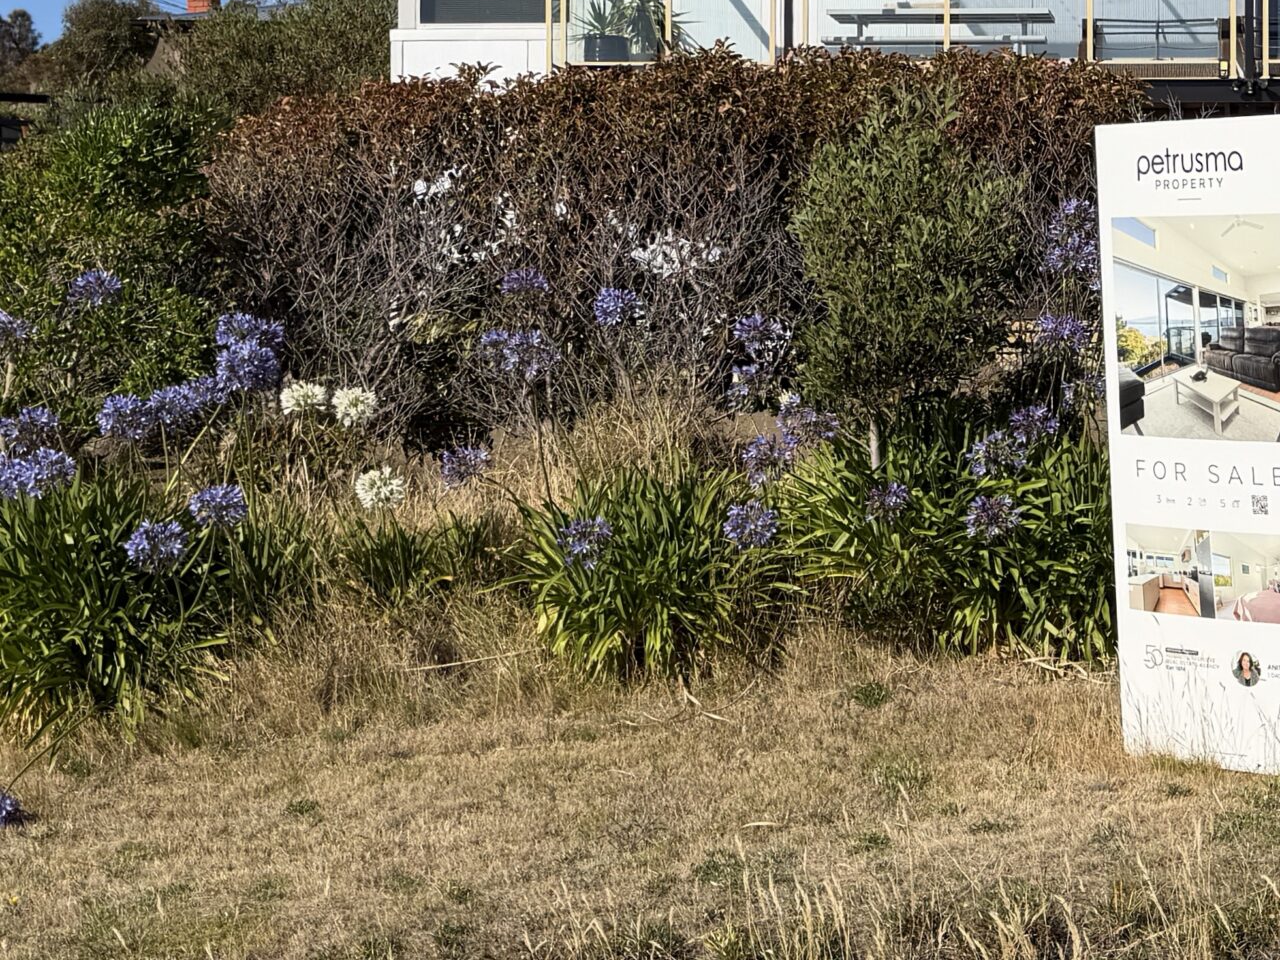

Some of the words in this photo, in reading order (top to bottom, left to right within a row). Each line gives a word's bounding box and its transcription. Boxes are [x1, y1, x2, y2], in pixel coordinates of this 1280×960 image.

[1136, 147, 1244, 182] petrusma
[1154, 177, 1224, 190] PROPERTY
[1135, 458, 1188, 482] FOR
[1156, 494, 1163, 504] 3
[1186, 496, 1193, 507] 2
